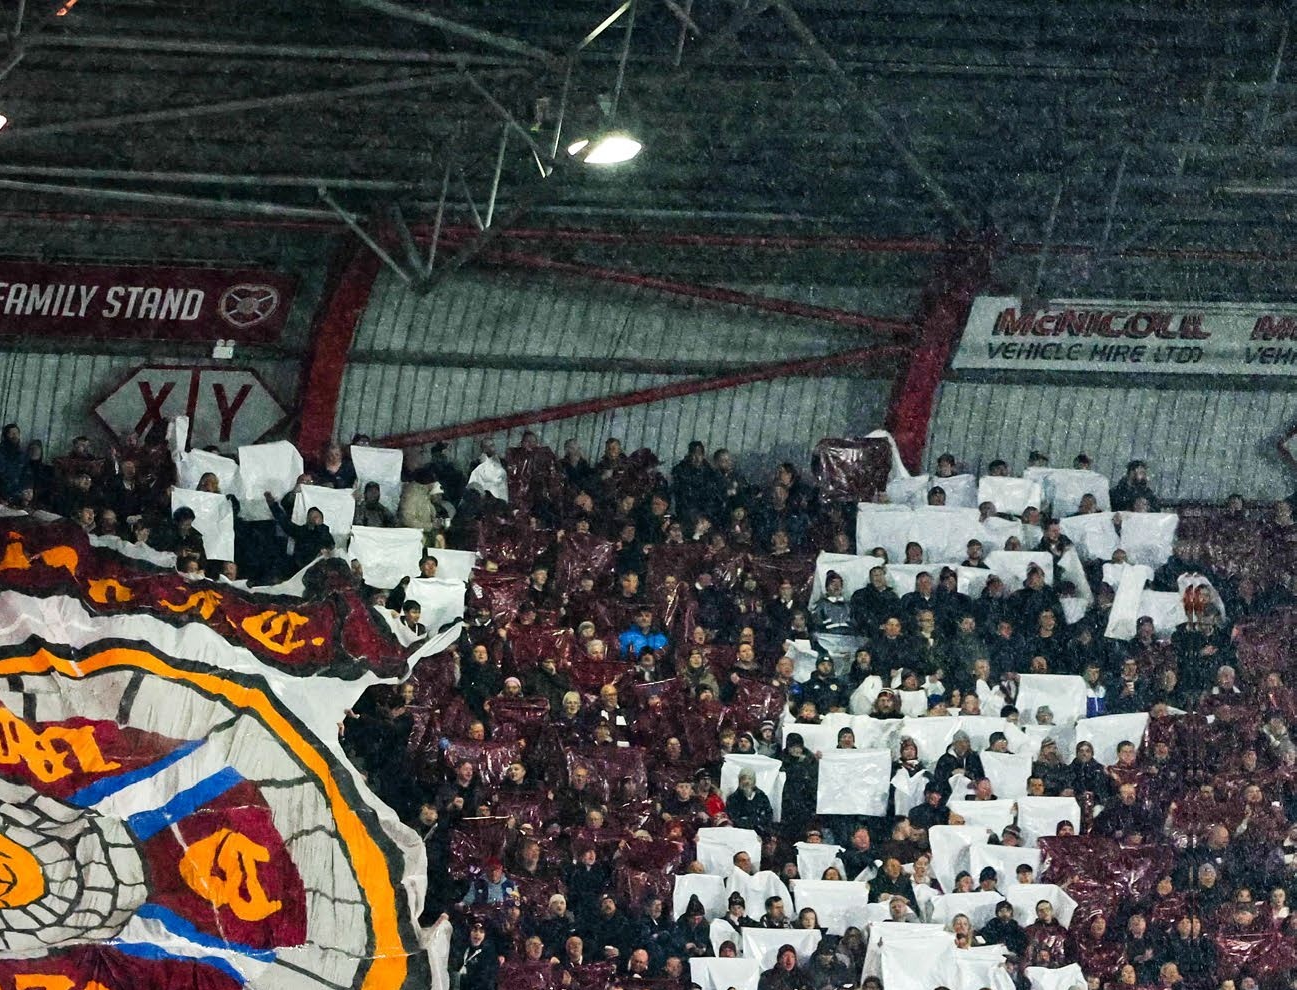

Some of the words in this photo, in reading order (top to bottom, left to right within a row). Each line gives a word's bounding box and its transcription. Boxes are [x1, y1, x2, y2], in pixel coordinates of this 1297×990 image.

[102, 287, 206, 321] STAND
[988, 342, 1083, 361] VEHICLE
[1088, 344, 1149, 363] HIRE
[135, 381, 175, 436] X
[212, 384, 253, 442] Y
